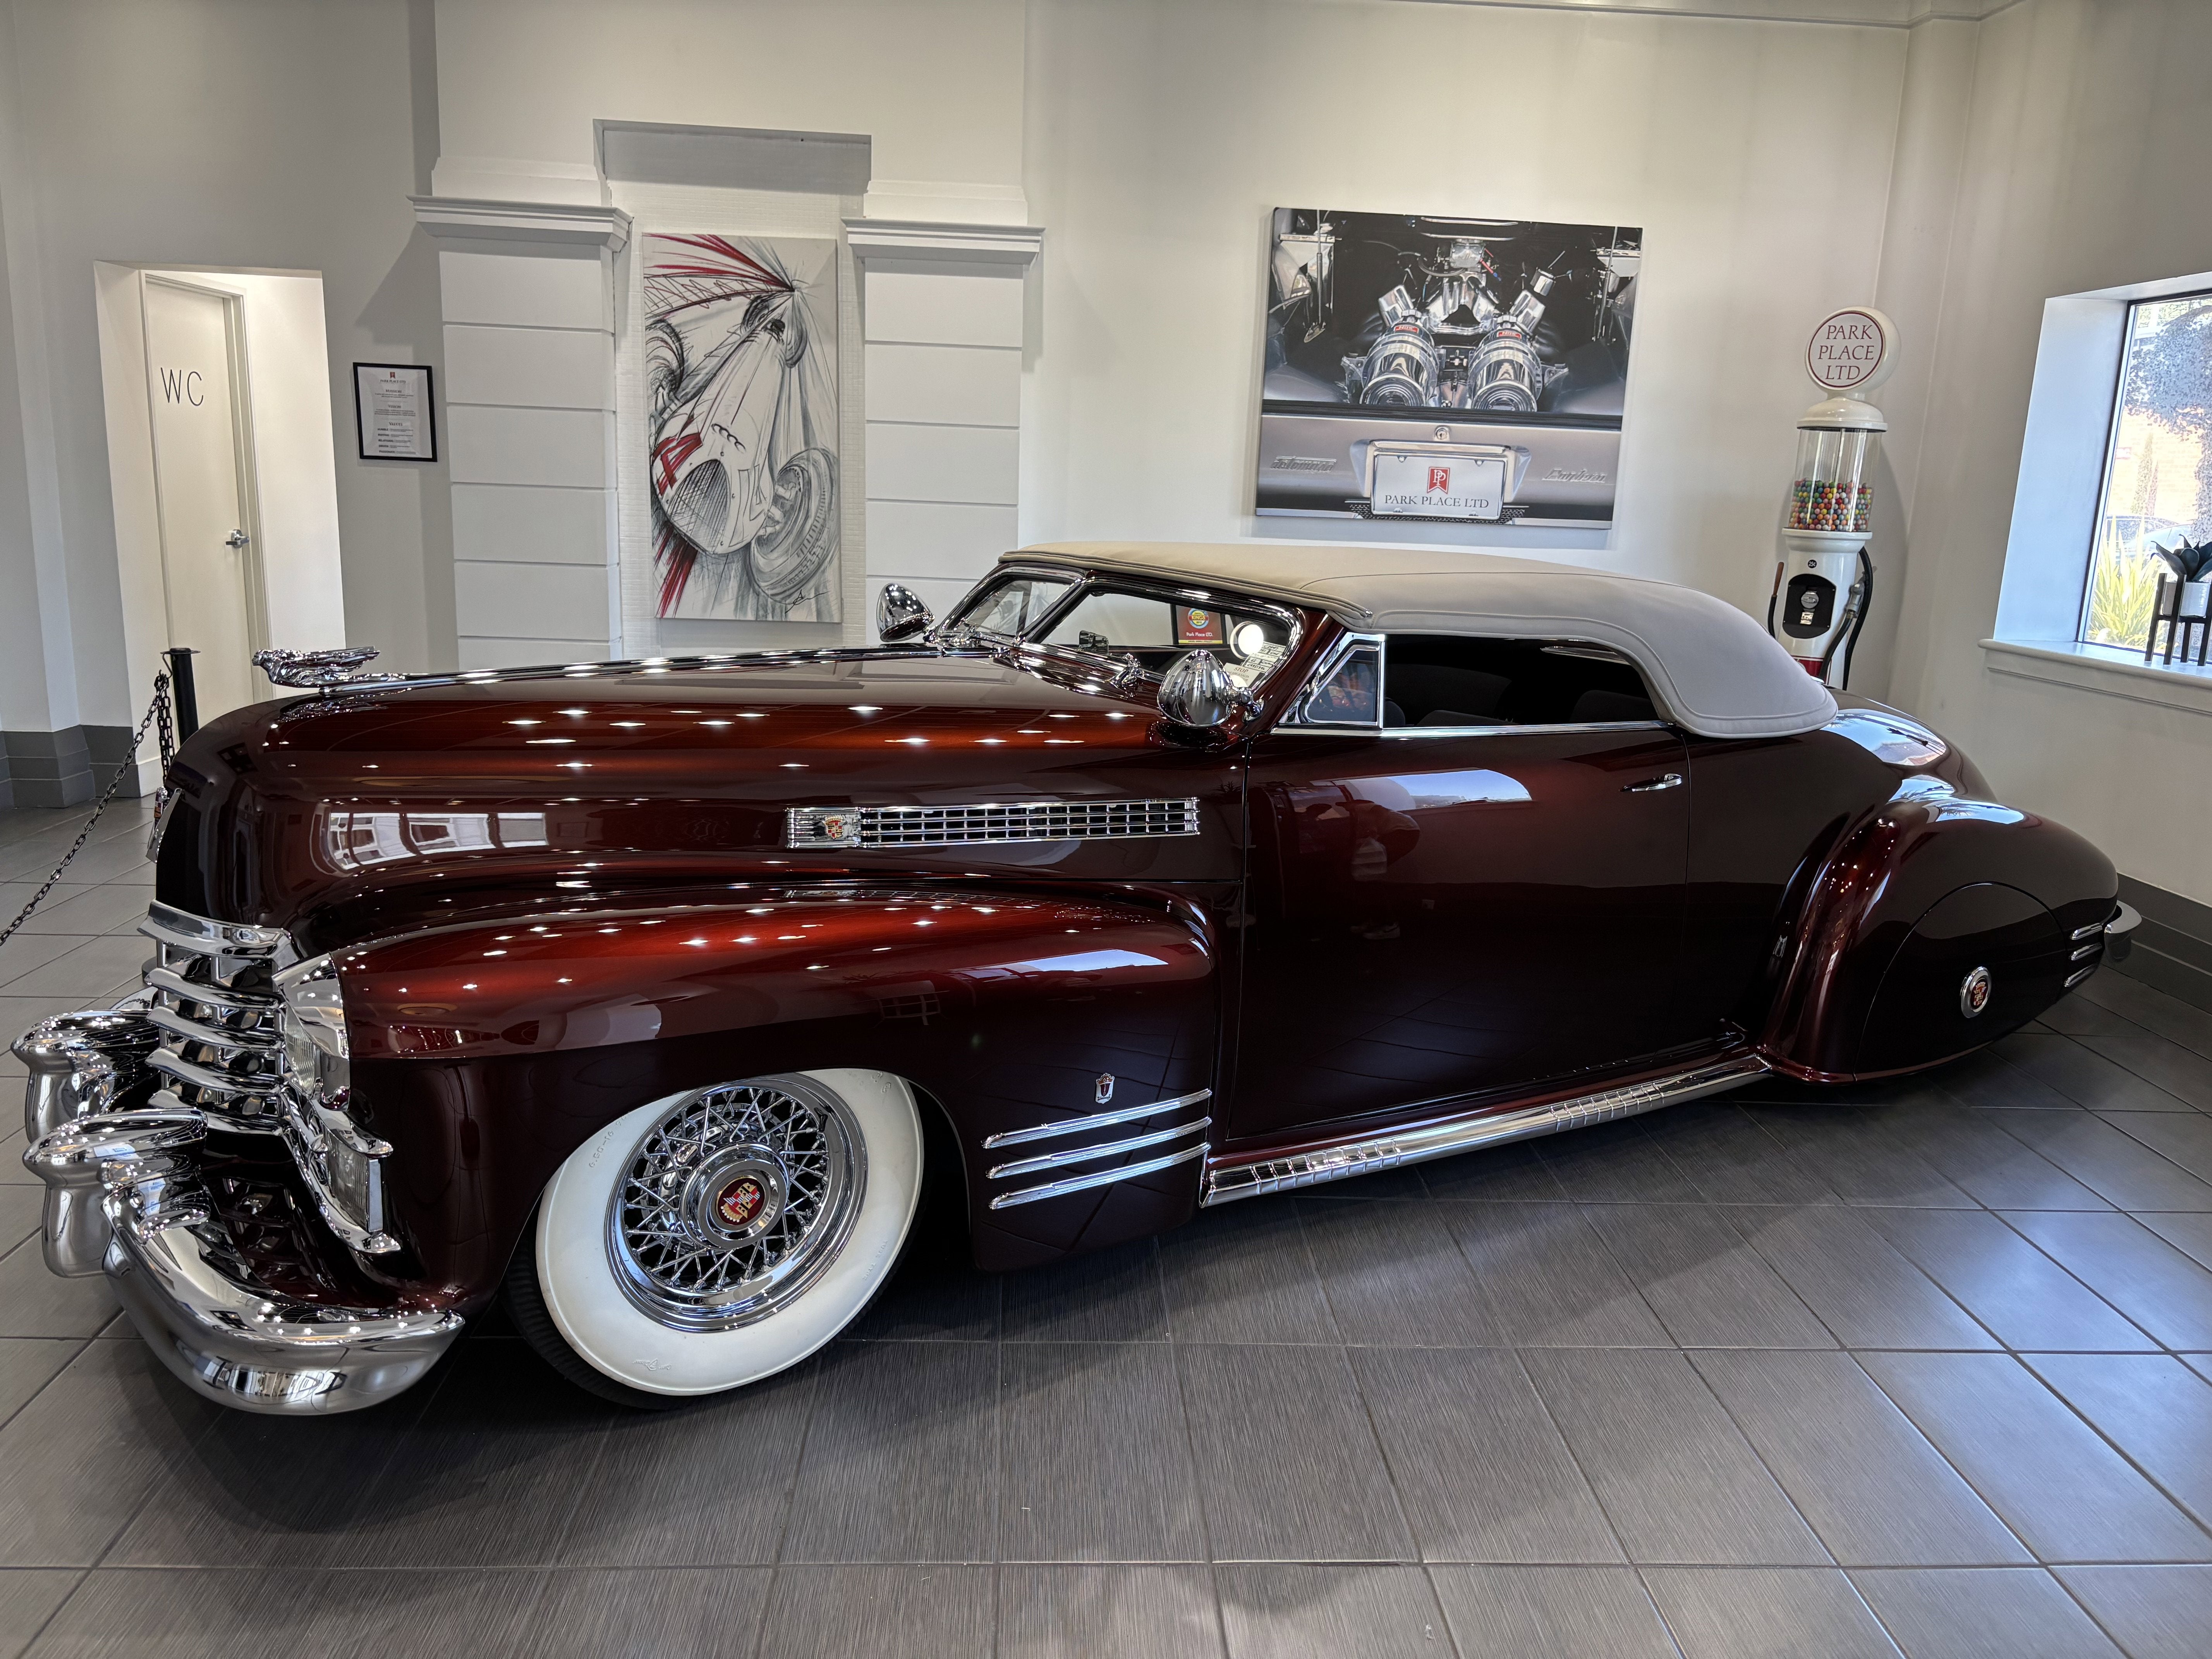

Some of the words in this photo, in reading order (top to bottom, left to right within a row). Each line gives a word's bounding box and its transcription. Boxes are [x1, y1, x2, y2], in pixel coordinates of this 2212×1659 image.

[1826, 325, 1872, 339] PARK
[1818, 345, 1874, 360] PLACE
[1825, 365, 1860, 380] LTD
[161, 367, 203, 406] WC
[1385, 495, 1418, 505] PARK
[1421, 496, 1461, 507] PLACE
[1465, 498, 1489, 508] LTD
